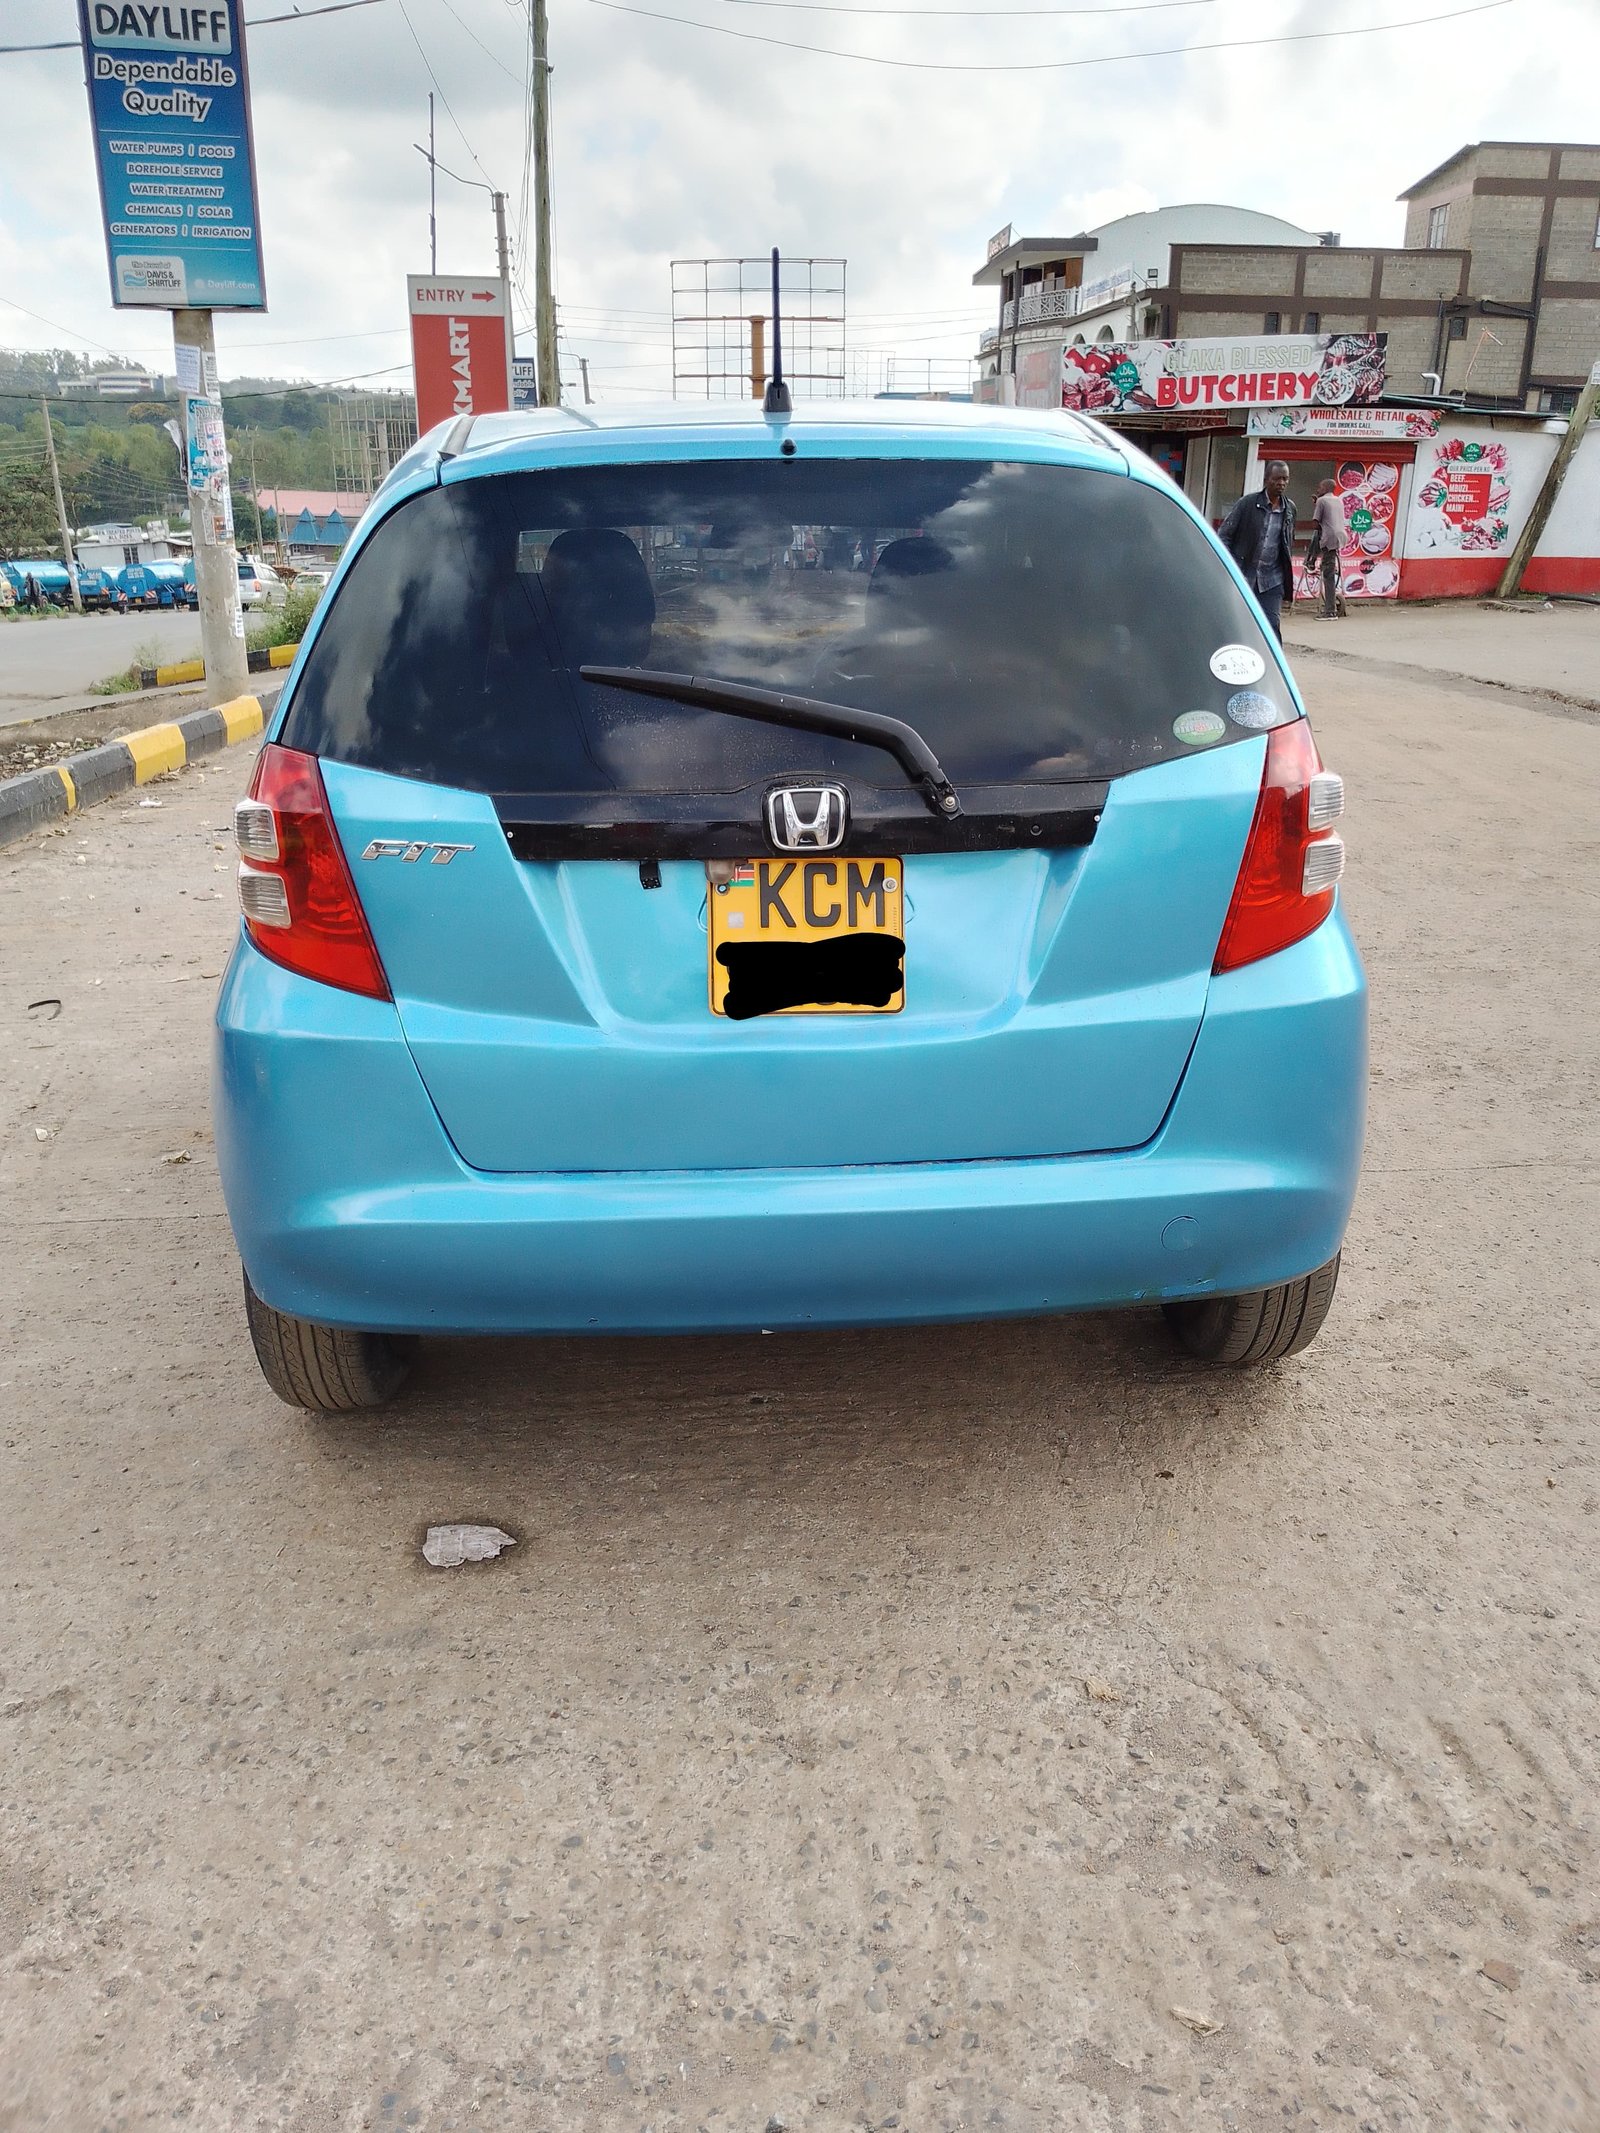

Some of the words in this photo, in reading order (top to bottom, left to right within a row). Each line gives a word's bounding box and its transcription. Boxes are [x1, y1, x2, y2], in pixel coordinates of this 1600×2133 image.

[95, 3, 227, 43] DAYLIFF
[95, 56, 235, 86] Dependable
[125, 91, 208, 119] Quality
[111, 142, 145, 153] WATER
[148, 144, 182, 155] PUMPS
[200, 147, 234, 158] POOLS
[128, 165, 180, 175] BOREHOLE
[183, 166, 221, 177] SERVICE
[131, 185, 165, 195] WATER
[167, 187, 223, 197] TREATMENT
[127, 205, 182, 215] CHEMICALS
[198, 207, 232, 217] SOLAR
[111, 225, 176, 236] GENERATORS
[193, 227, 250, 238] IRRIGATION
[146, 270, 168, 279] DAVIS
[169, 271, 174, 279] &
[147, 279, 181, 288] SHIRTLIFF
[207, 280, 256, 290] Dayliff.com
[416, 288, 465, 302] ENTRY
[1231, 345, 1314, 370] BLESSED
[448, 317, 473, 416] KMART
[512, 366, 532, 376] LIFF
[1156, 370, 1321, 407] BUTCHERY
[1309, 409, 1363, 421] WHOLESALE
[1365, 410, 1372, 421] &
[1375, 411, 1405, 422] RETAIL
[361, 839, 477, 865] FIT
[758, 862, 886, 929] KCM
